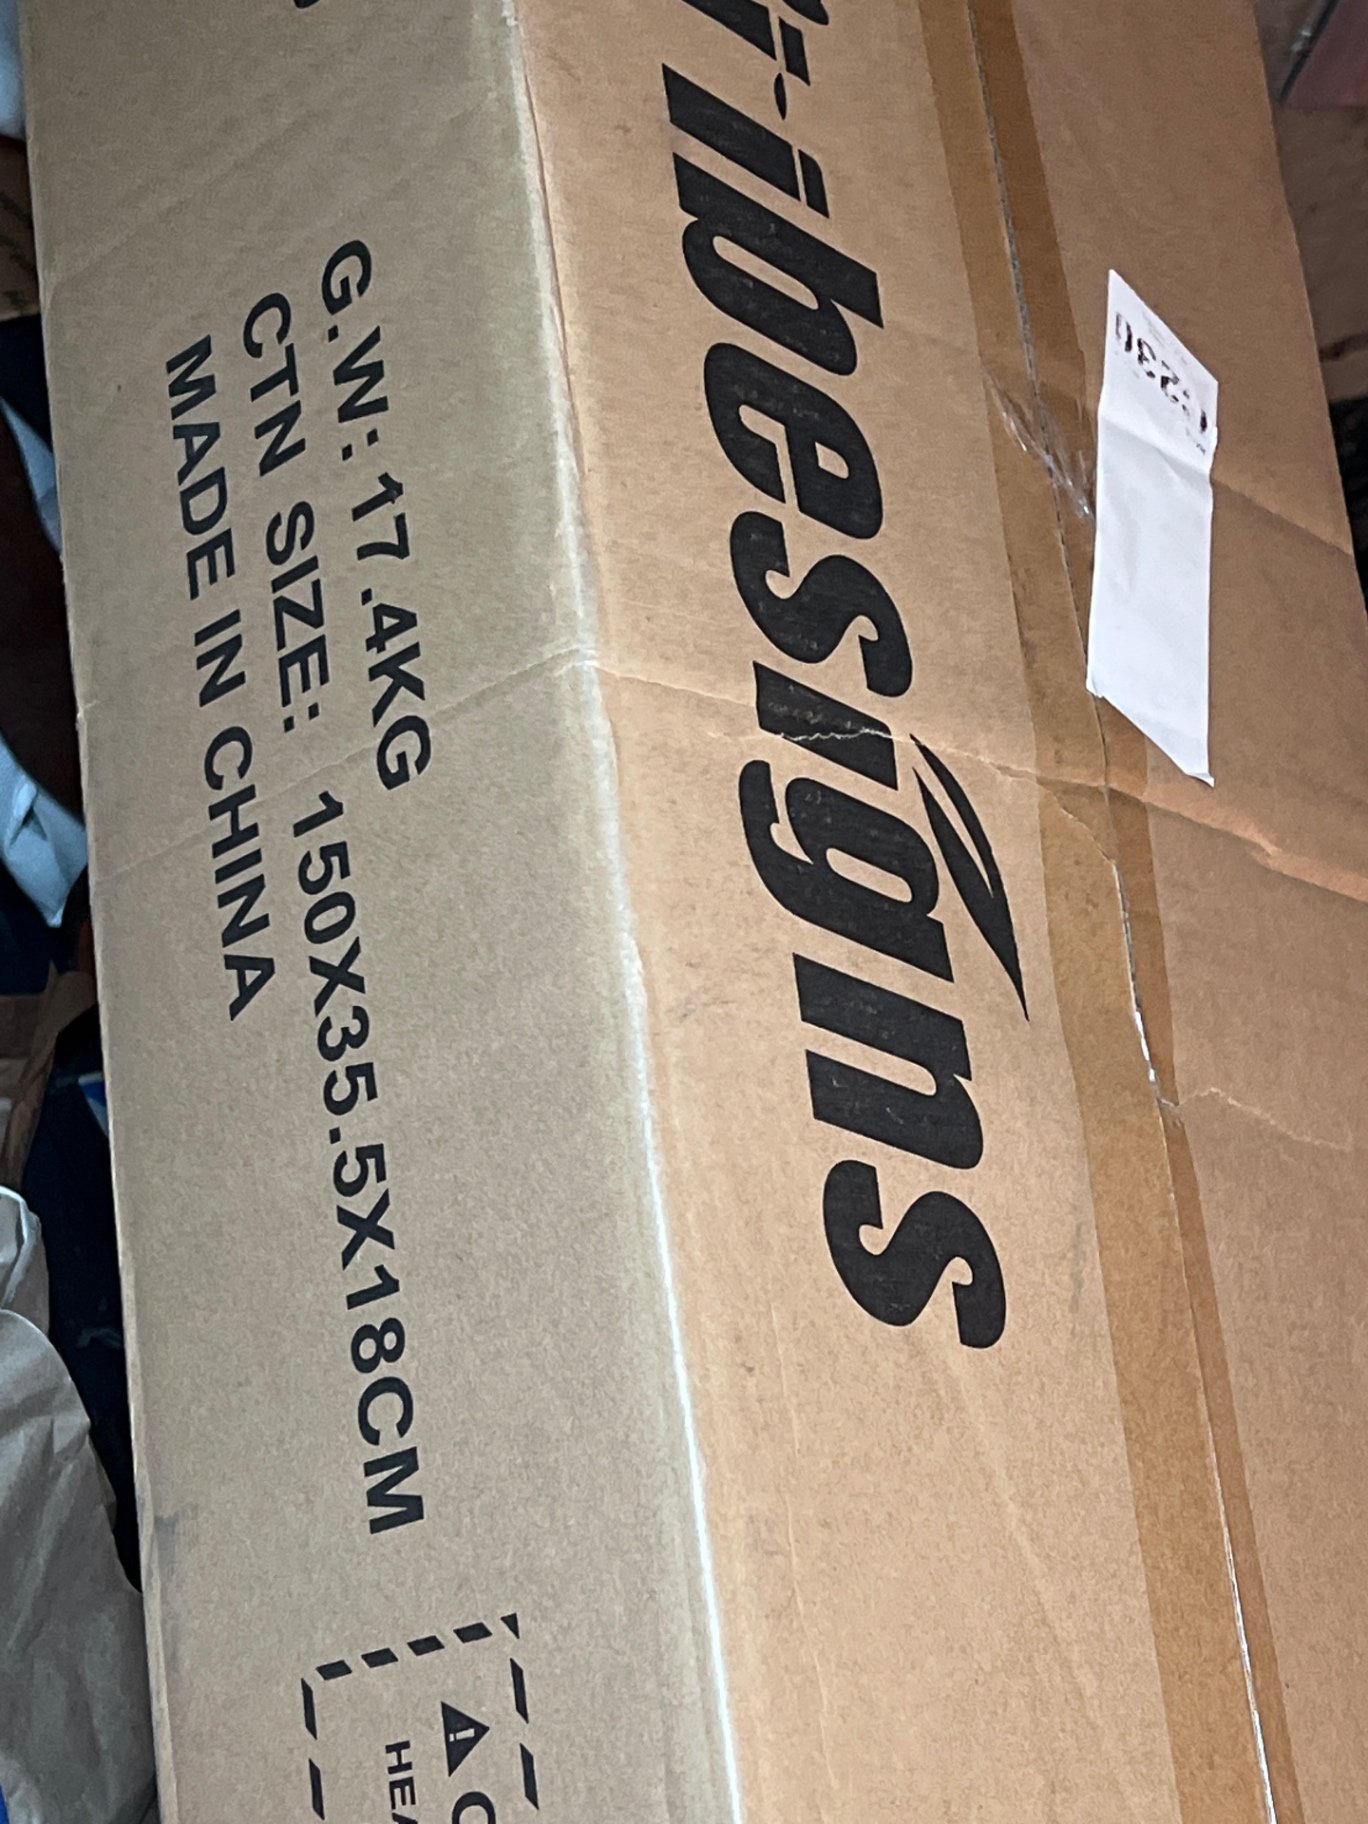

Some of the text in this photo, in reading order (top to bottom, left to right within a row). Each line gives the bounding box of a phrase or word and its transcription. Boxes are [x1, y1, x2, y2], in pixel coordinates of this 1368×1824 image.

[166, 335, 275, 1022] MADE IN CHINA
[322, 240, 430, 790] G.W: 17.4KG
[243, 293, 423, 1534] CTN SIZE: 150X35.5X18CM
